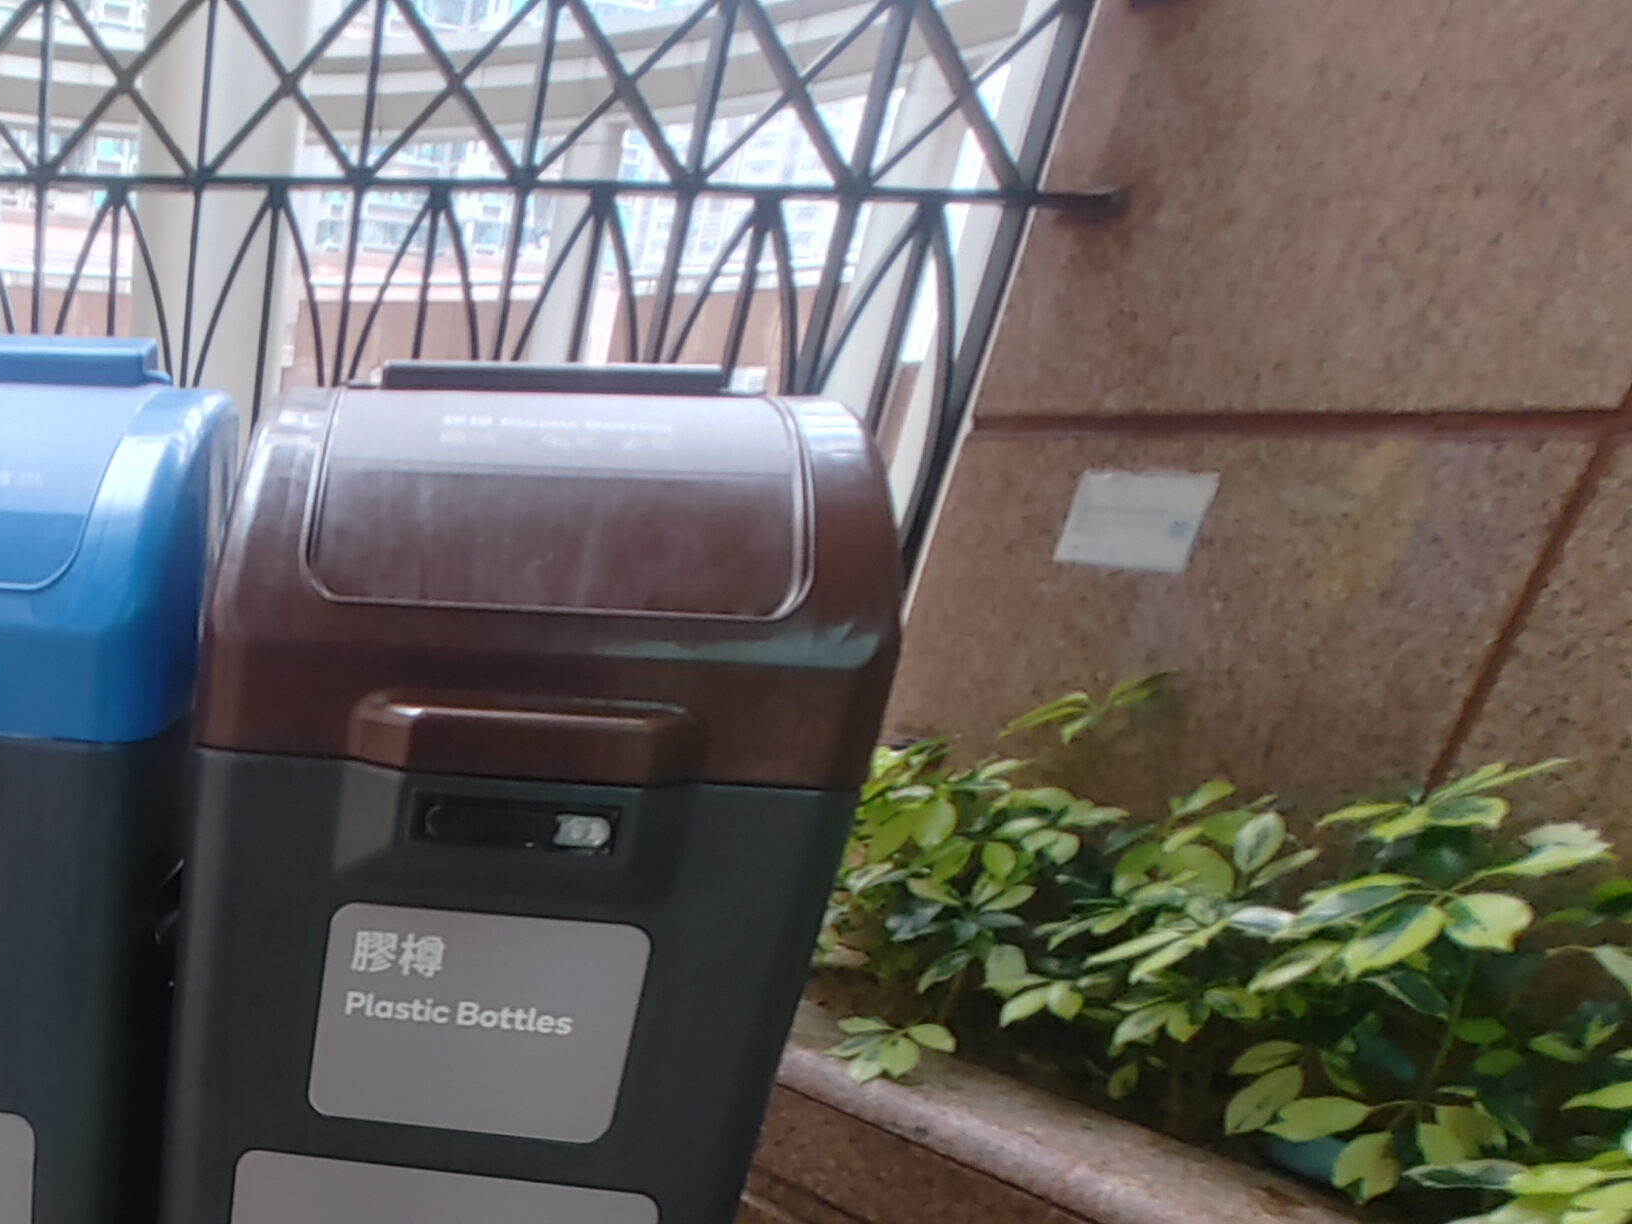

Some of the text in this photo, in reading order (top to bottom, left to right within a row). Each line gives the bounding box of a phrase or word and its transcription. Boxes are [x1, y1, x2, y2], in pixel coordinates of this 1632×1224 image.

[349, 930, 446, 978] 膠樽
[343, 990, 575, 1037] Plastic Bottles
